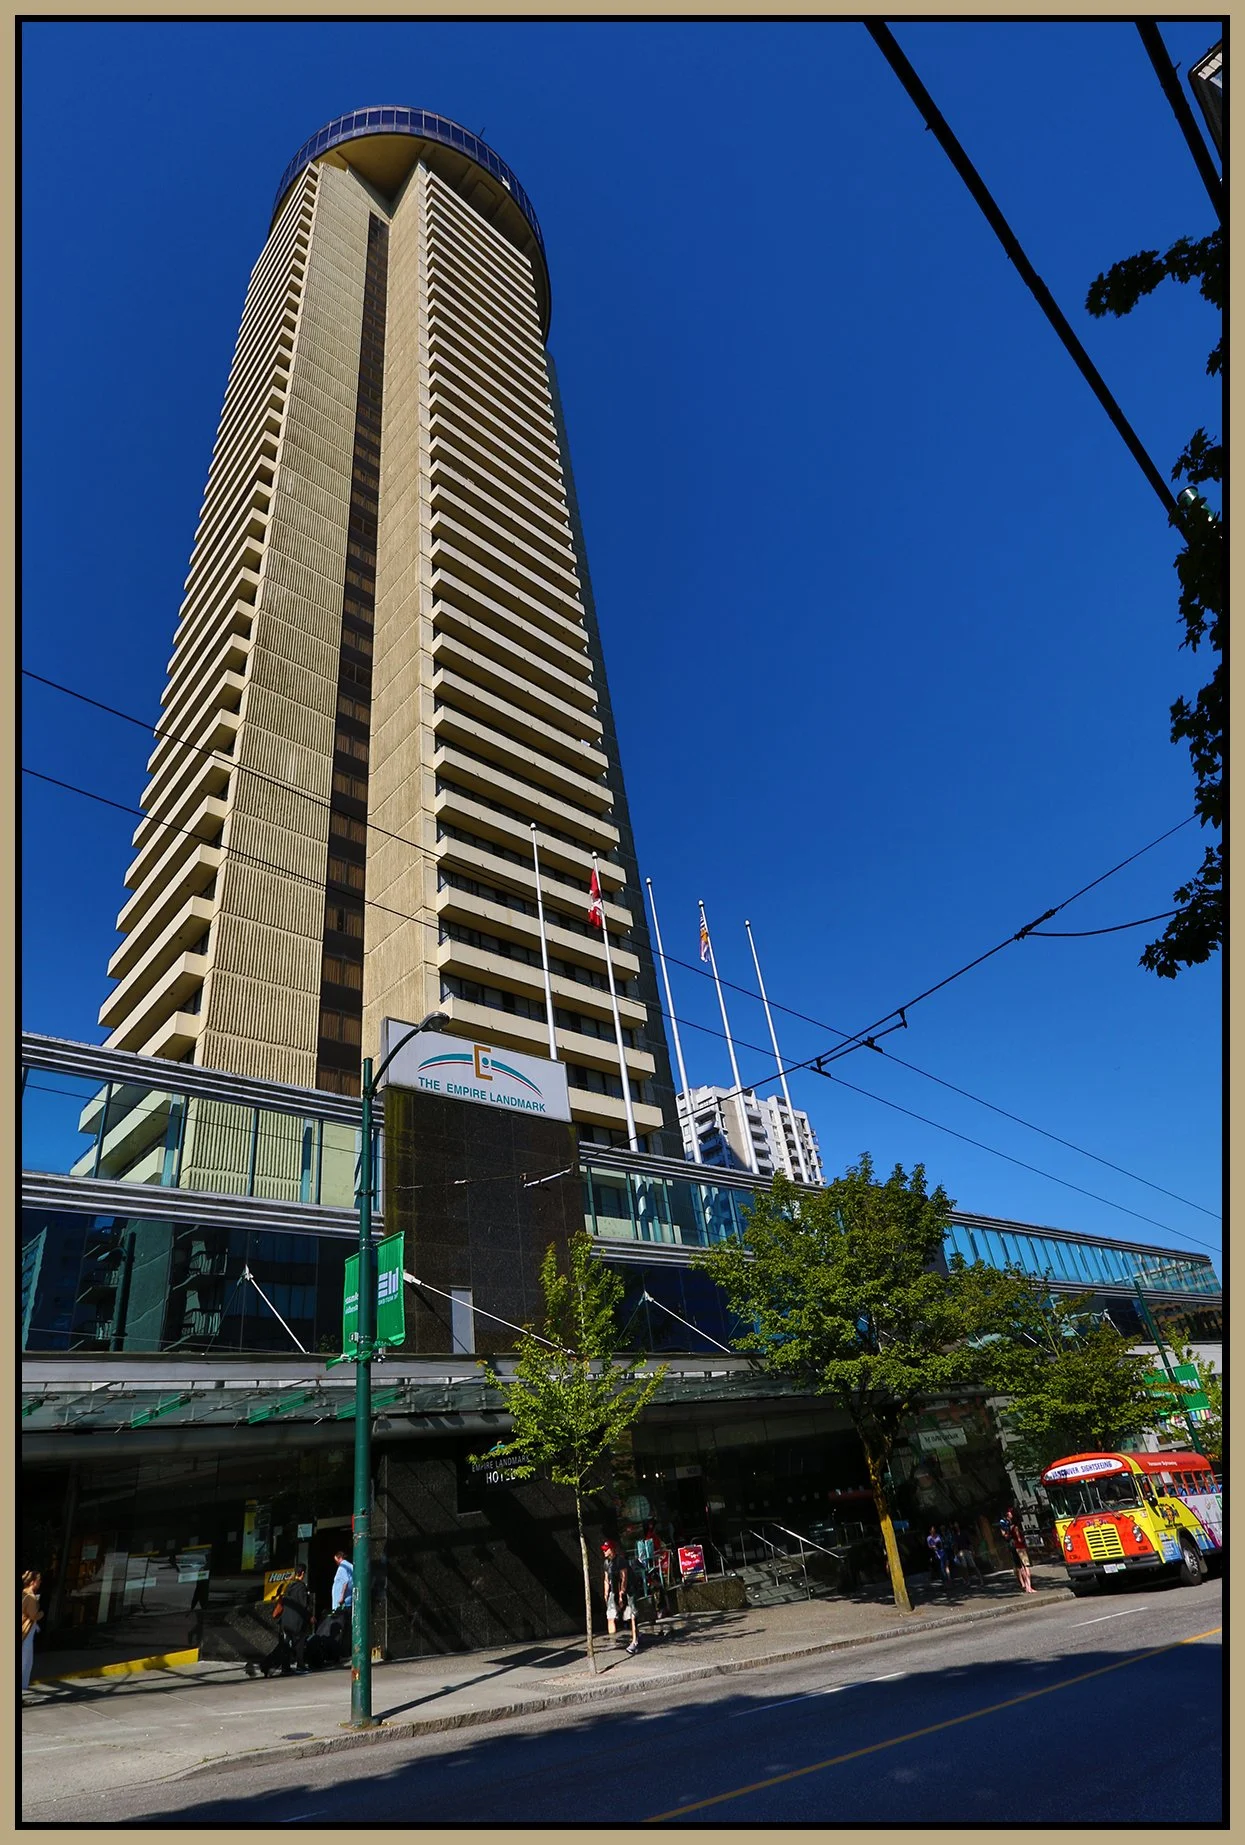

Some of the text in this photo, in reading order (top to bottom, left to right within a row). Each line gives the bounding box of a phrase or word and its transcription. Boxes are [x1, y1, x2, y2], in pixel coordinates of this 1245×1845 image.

[418, 1076, 546, 1113] THE EMPIRE LANDMARK
[495, 1454, 529, 1468] LANDMARK
[1051, 1460, 1113, 1480] VANCOUVER SIGHTSEEING
[485, 1469, 516, 1485] HOTL
